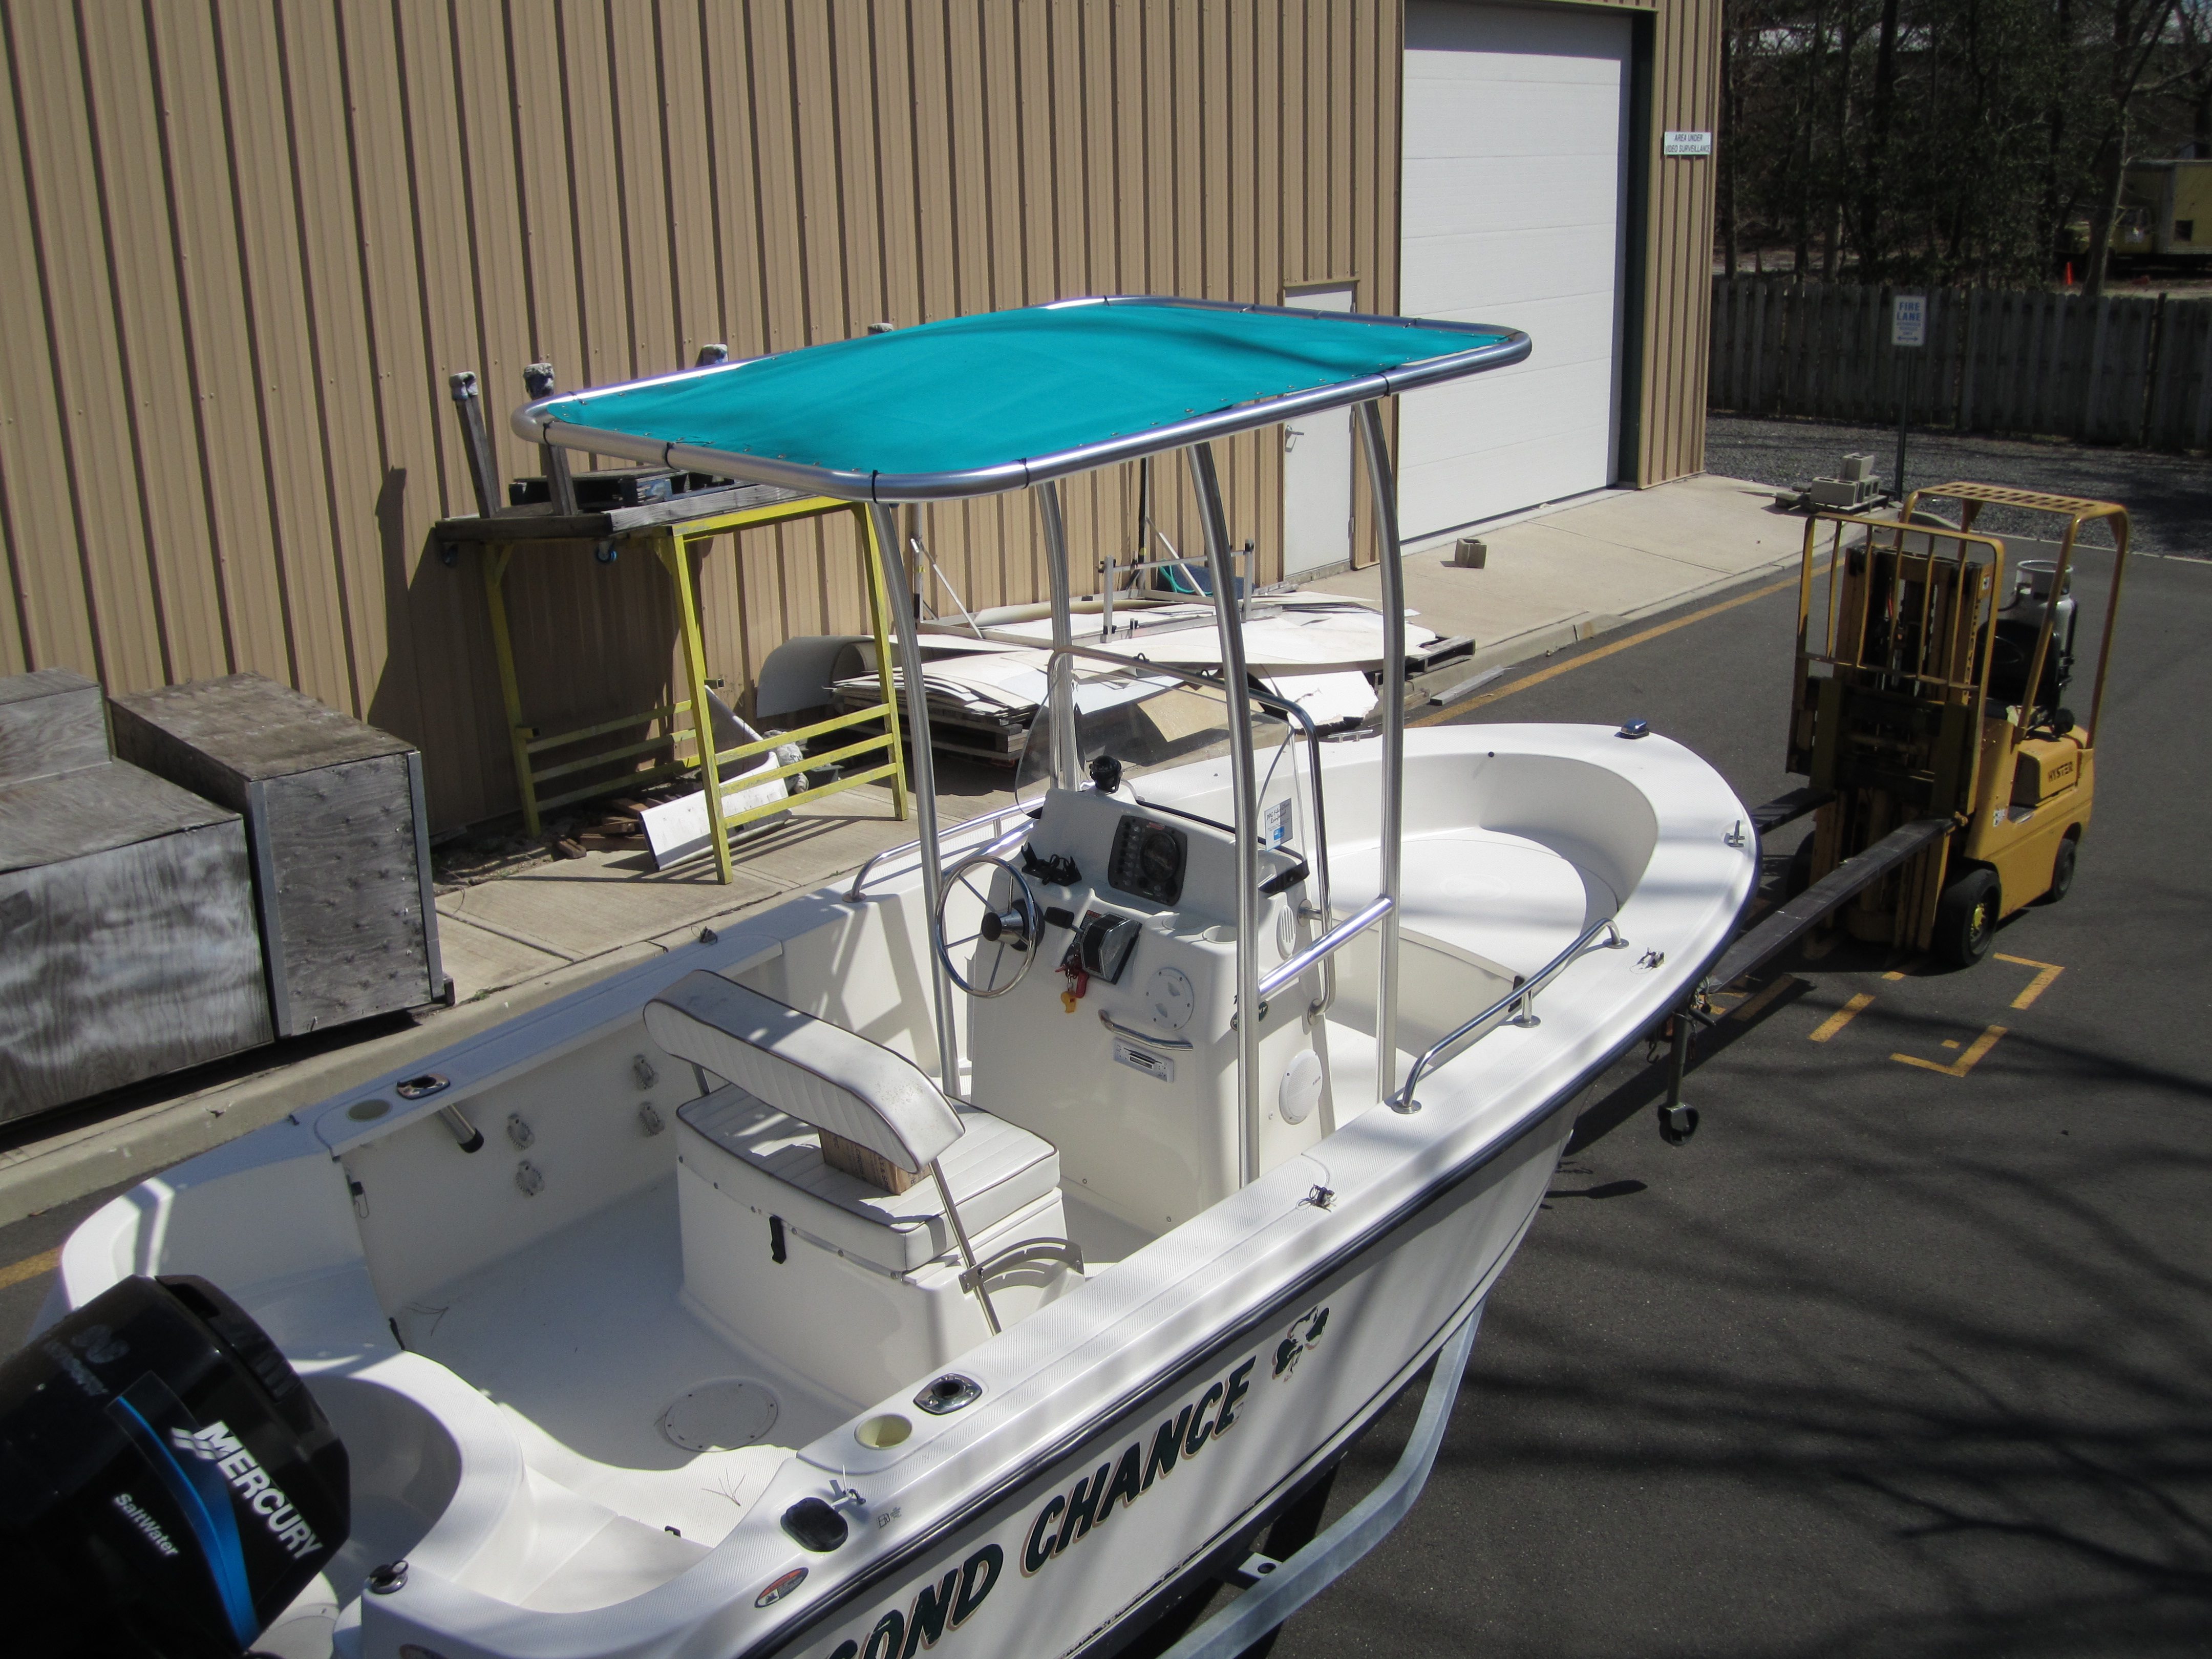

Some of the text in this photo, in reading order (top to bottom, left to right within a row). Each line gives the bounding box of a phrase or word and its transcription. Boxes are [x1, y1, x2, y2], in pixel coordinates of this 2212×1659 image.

[1679, 144, 1710, 153] SURVEILLANCE
[1897, 312, 1921, 321] LANE
[1899, 302, 1920, 311] FIRE
[2048, 761, 2073, 782] HYSTER
[1020, 1355, 1257, 1578] CHANCE
[193, 1419, 324, 1559] MERCURY
[113, 1493, 180, 1557] SaltWater
